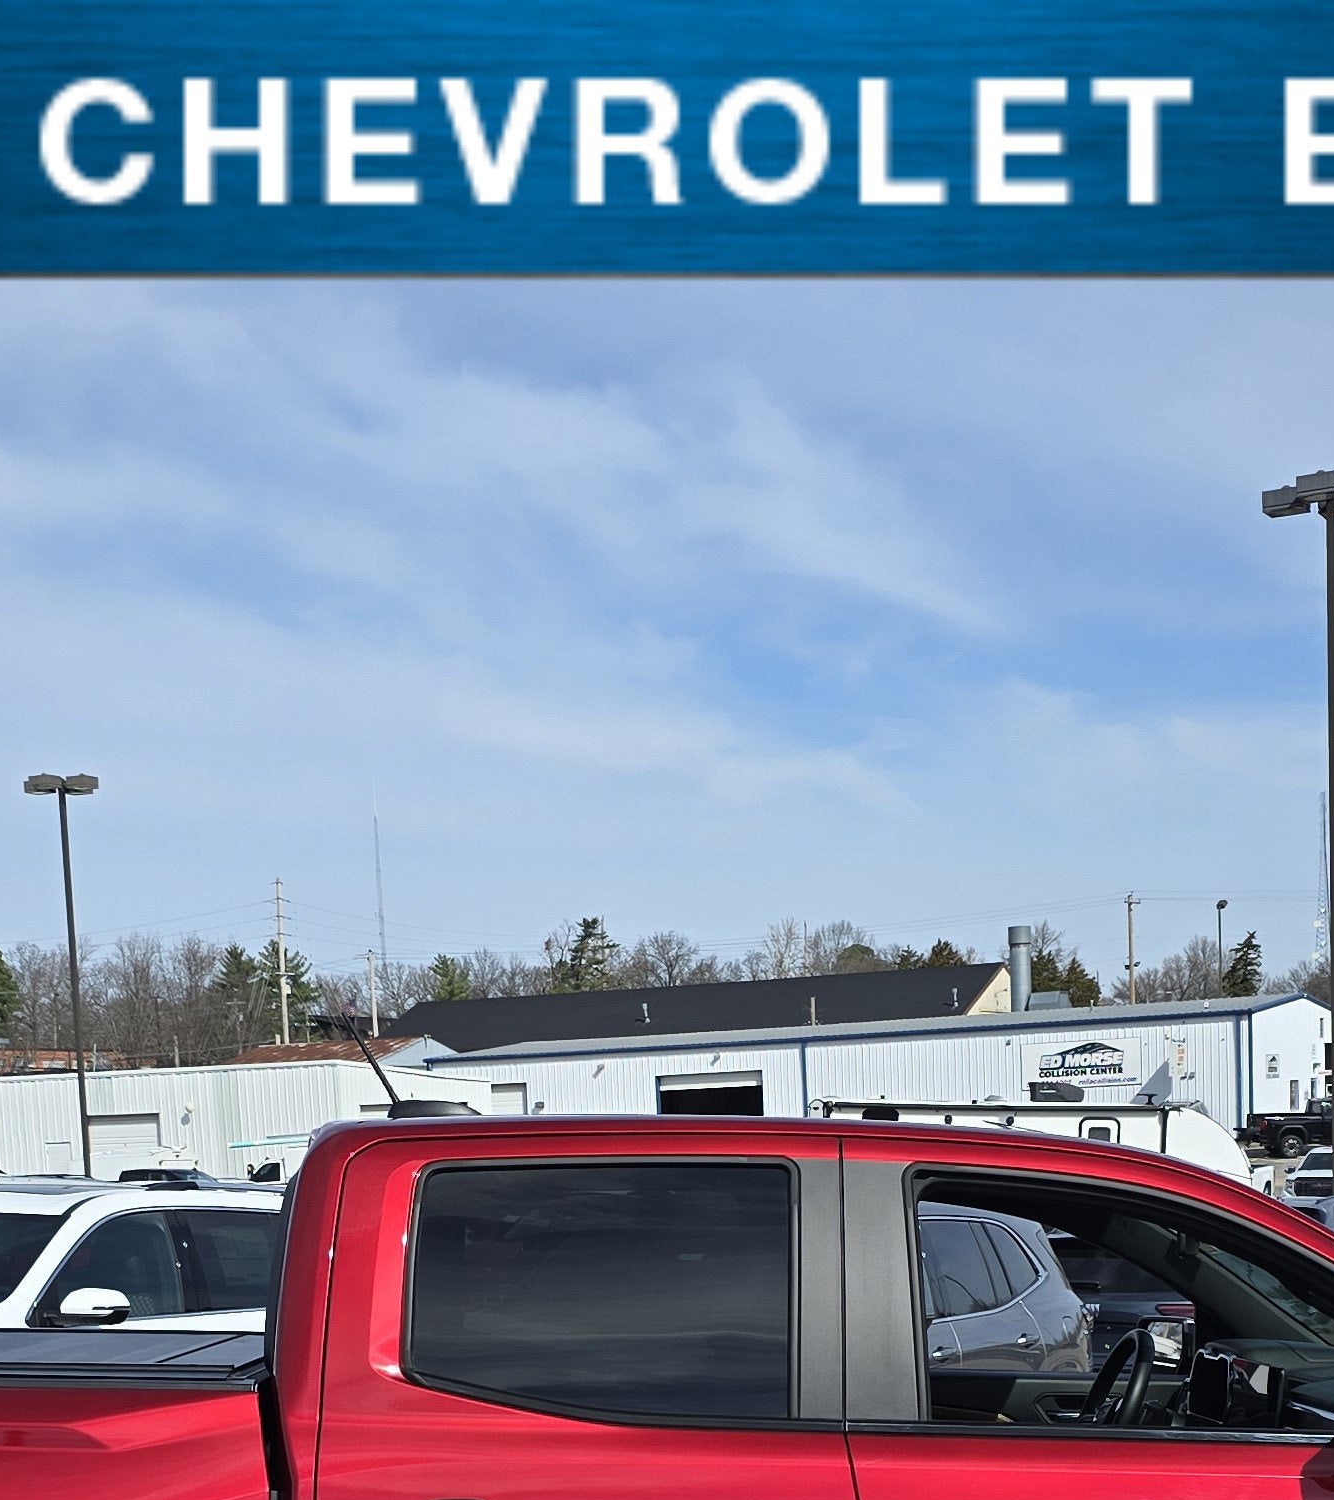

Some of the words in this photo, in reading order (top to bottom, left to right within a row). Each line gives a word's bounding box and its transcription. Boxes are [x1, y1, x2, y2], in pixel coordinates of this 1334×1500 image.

[1040, 1055, 1063, 1069] ED
[1064, 1050, 1124, 1067] MORSE
[1039, 1068, 1087, 1078] COLLISION
[1090, 1066, 1124, 1075] CENTER
